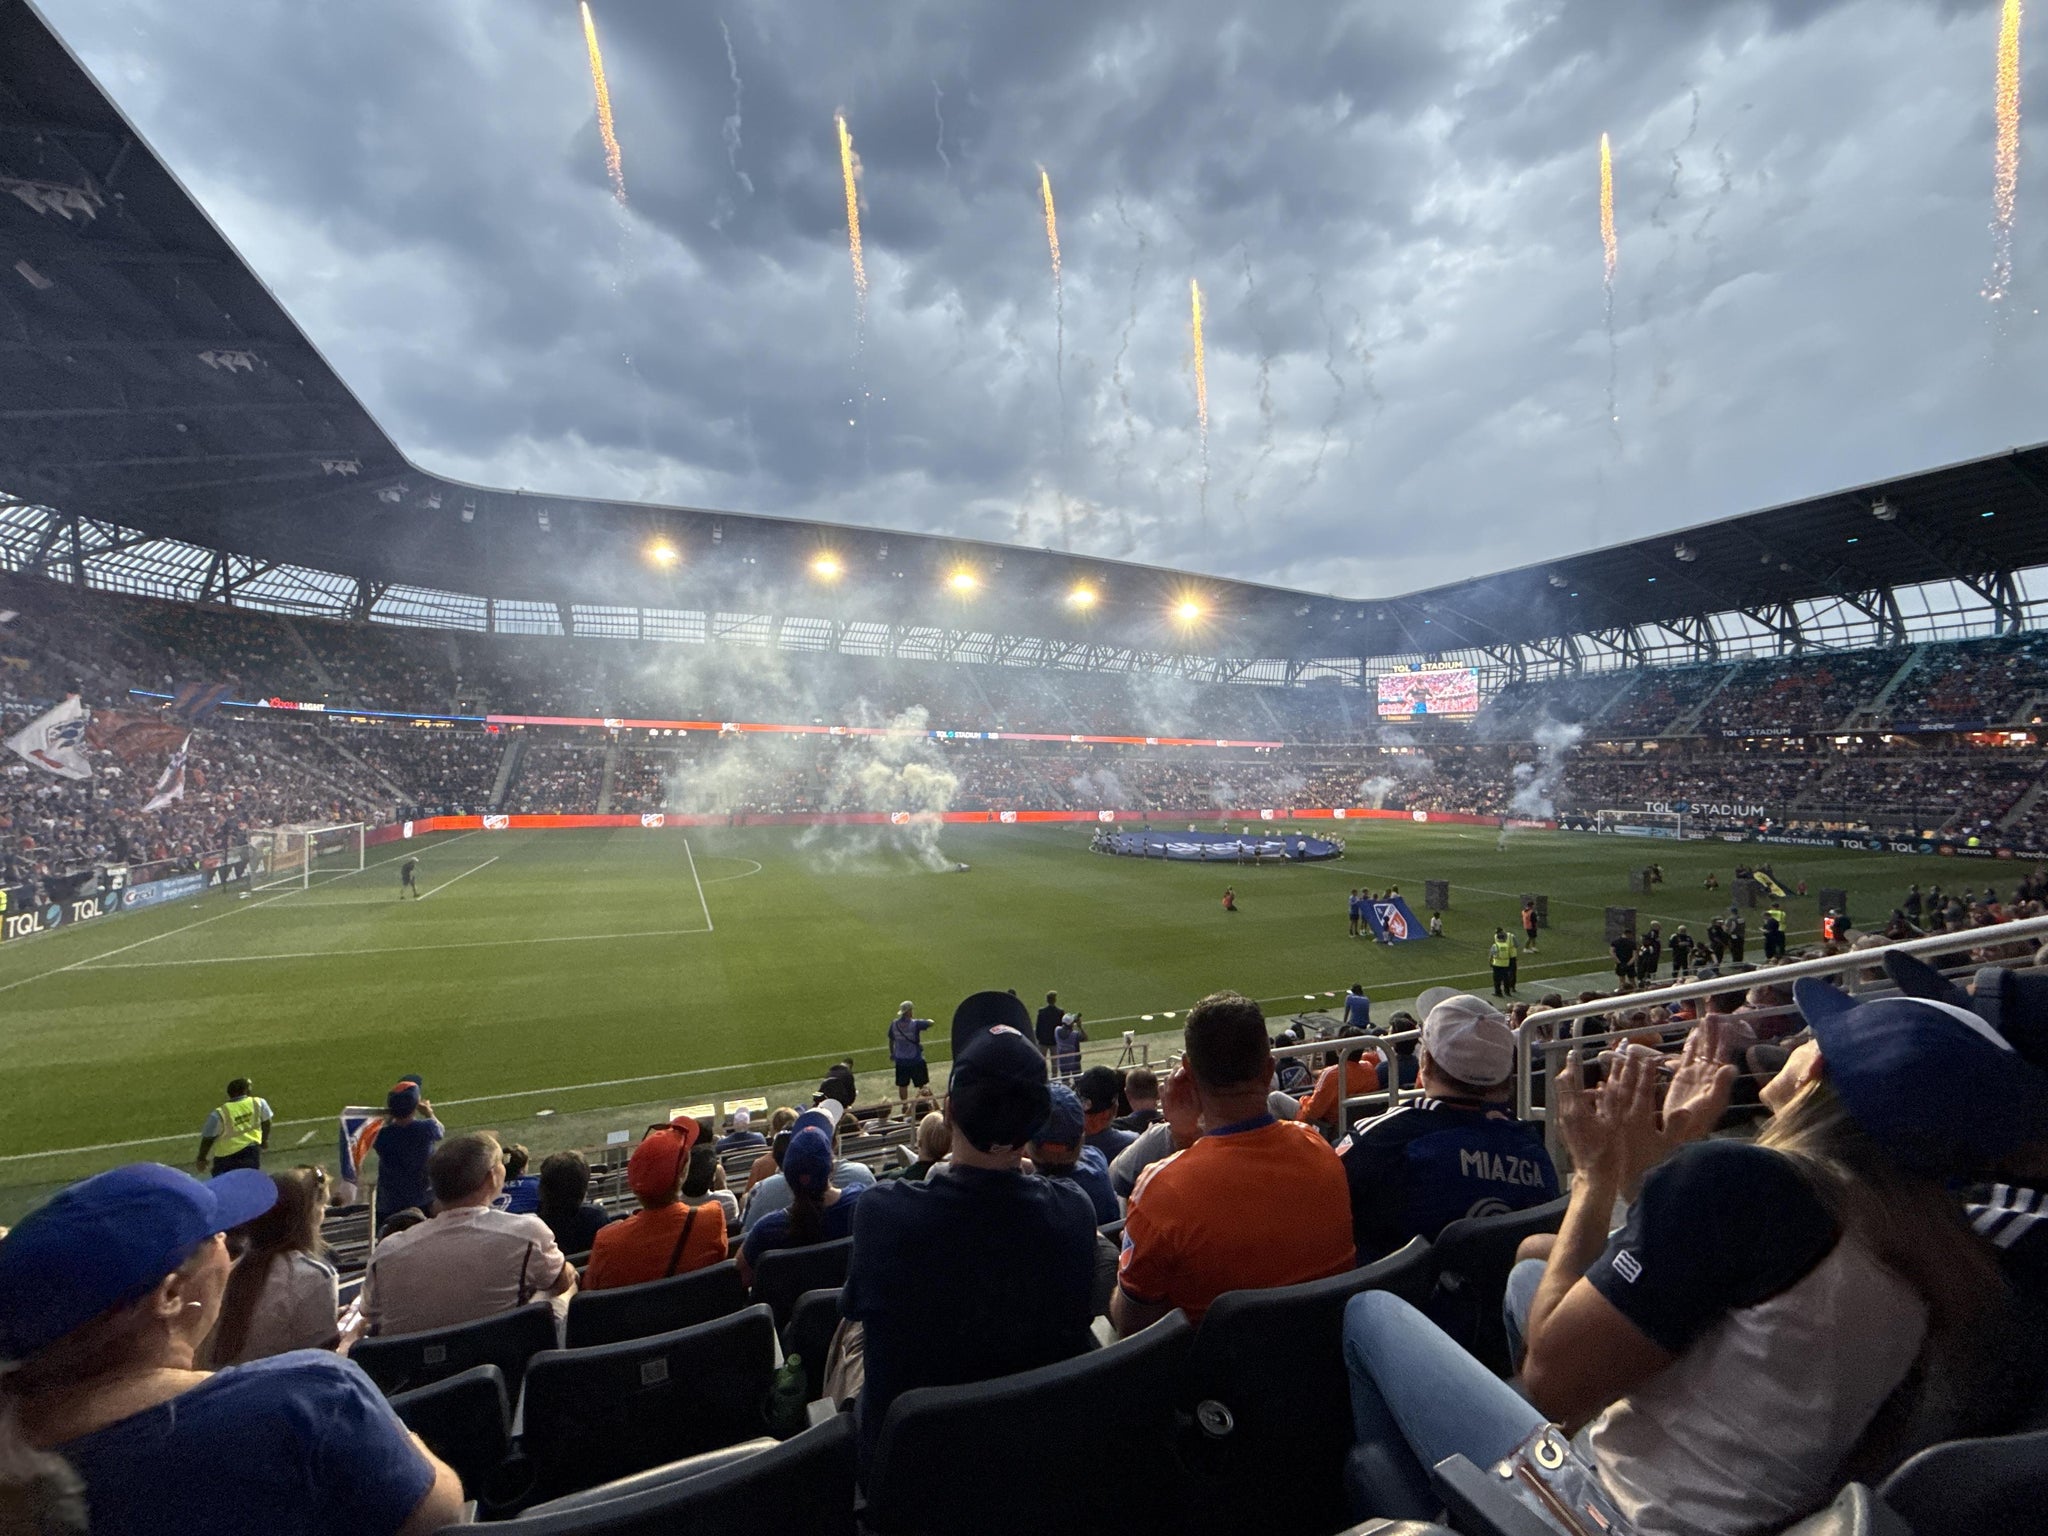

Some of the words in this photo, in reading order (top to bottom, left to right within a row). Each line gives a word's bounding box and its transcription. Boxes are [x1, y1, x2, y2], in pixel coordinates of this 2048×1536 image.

[1393, 665, 1411, 673] TQL
[1420, 661, 1463, 671] STADIUM
[299, 702, 325, 711] LIGHT
[1749, 728, 1791, 736] STADIUM
[1644, 801, 1673, 813] TQL
[1691, 803, 1764, 816] STADIUM
[1767, 835, 1834, 846] MERCYHEALTH
[1841, 839, 1867, 850] TQL
[1888, 842, 1917, 853] TQL
[1957, 848, 1992, 856] TOYOTA
[72, 898, 104, 922] TQL
[6, 911, 45, 938] TQL
[1460, 1148, 1545, 1188] MIAZGA
